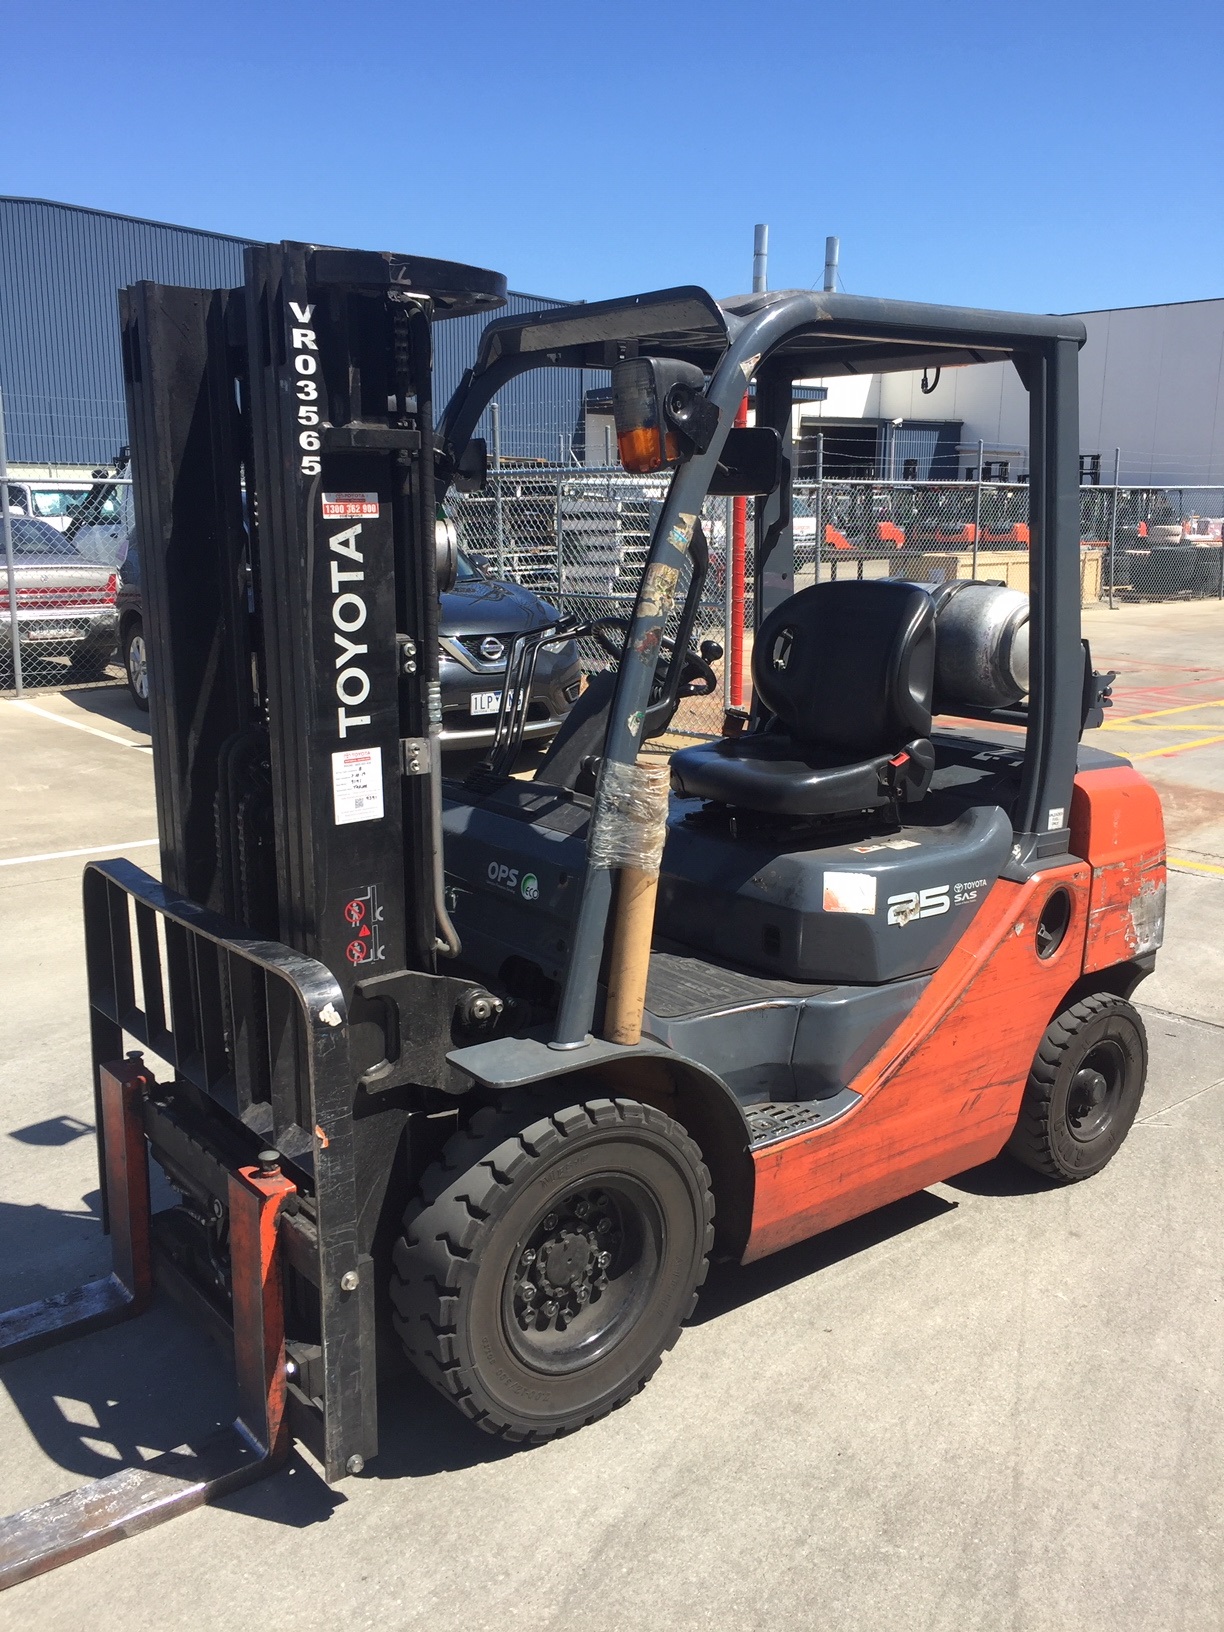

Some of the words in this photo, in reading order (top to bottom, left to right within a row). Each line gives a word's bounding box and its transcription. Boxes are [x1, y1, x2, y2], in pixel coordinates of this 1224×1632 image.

[289, 302, 322, 475] VR03565
[325, 504, 345, 514] 1300
[346, 504, 361, 513] 362
[362, 504, 377, 513] 900
[329, 523, 371, 738] TOYOTA
[488, 861, 519, 887] OPS
[963, 879, 987, 891] TOYOTA
[887, 884, 950, 926] 25
[954, 890, 977, 903] SAS
